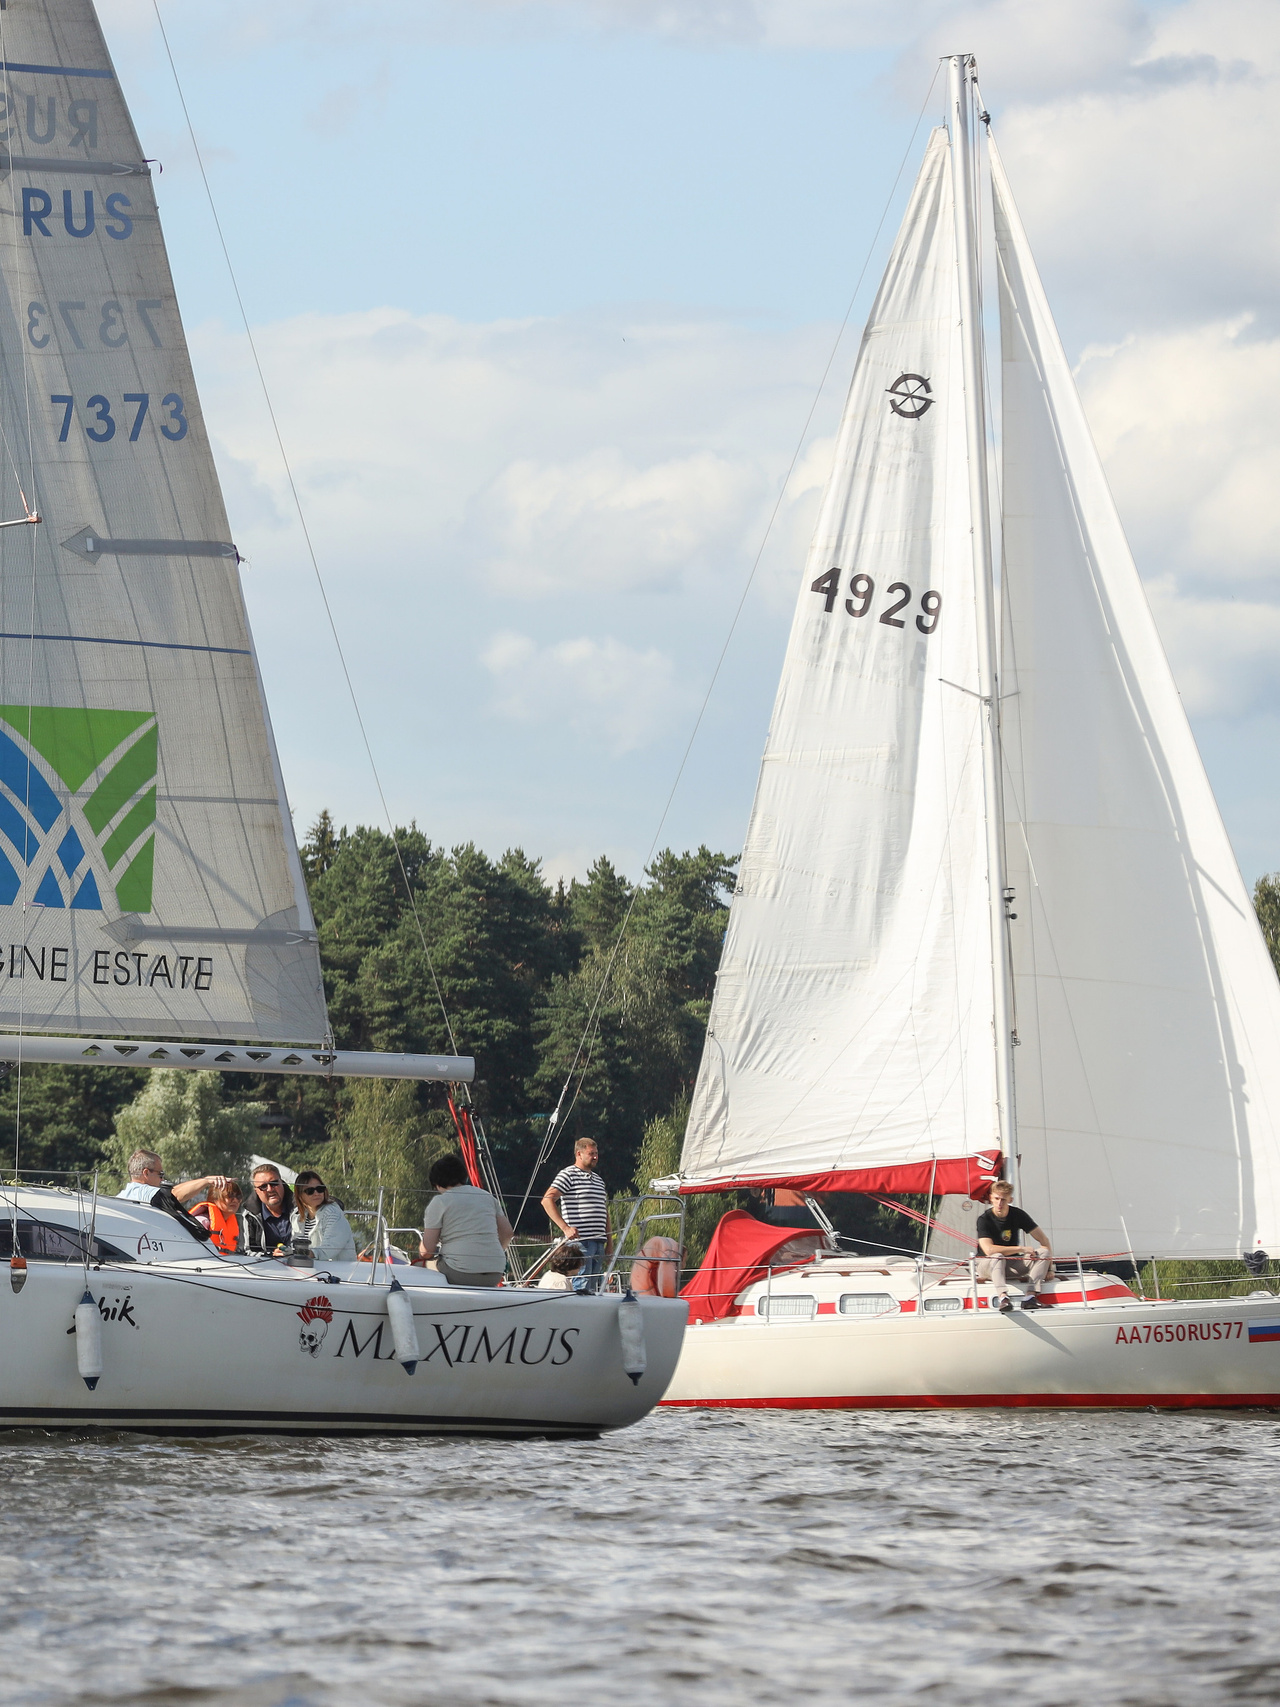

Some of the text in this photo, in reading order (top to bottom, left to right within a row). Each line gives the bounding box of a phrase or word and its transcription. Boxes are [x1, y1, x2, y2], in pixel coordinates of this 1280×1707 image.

[21, 186, 134, 241] RUS
[50, 392, 189, 443] 7373
[810, 566, 943, 635] 4929
[93, 949, 213, 991] ESTATE
[66, 1294, 136, 1335] hik
[1115, 1321, 1244, 1345] AA7650RUS77
[333, 1318, 581, 1368] MXIMUS
